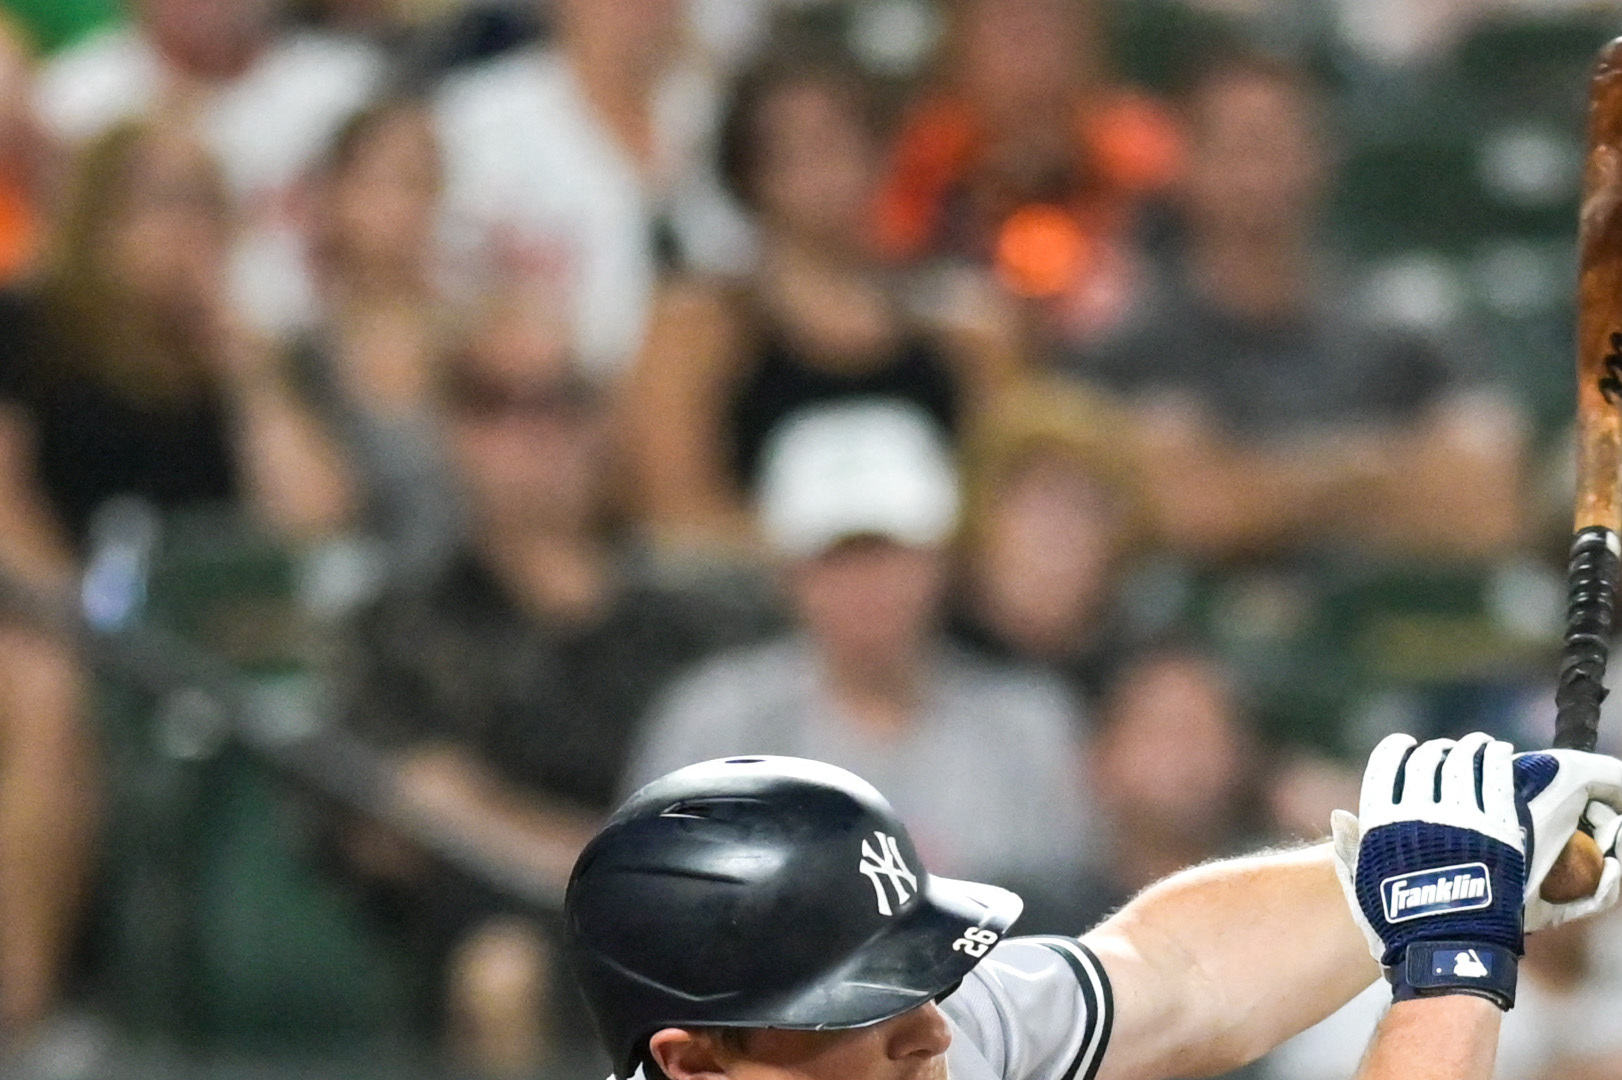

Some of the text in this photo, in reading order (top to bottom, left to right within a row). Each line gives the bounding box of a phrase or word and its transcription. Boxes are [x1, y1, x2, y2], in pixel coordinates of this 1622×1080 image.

[859, 831, 918, 916] NY
[1390, 873, 1486, 918] Franklin
[952, 926, 998, 958] 26
